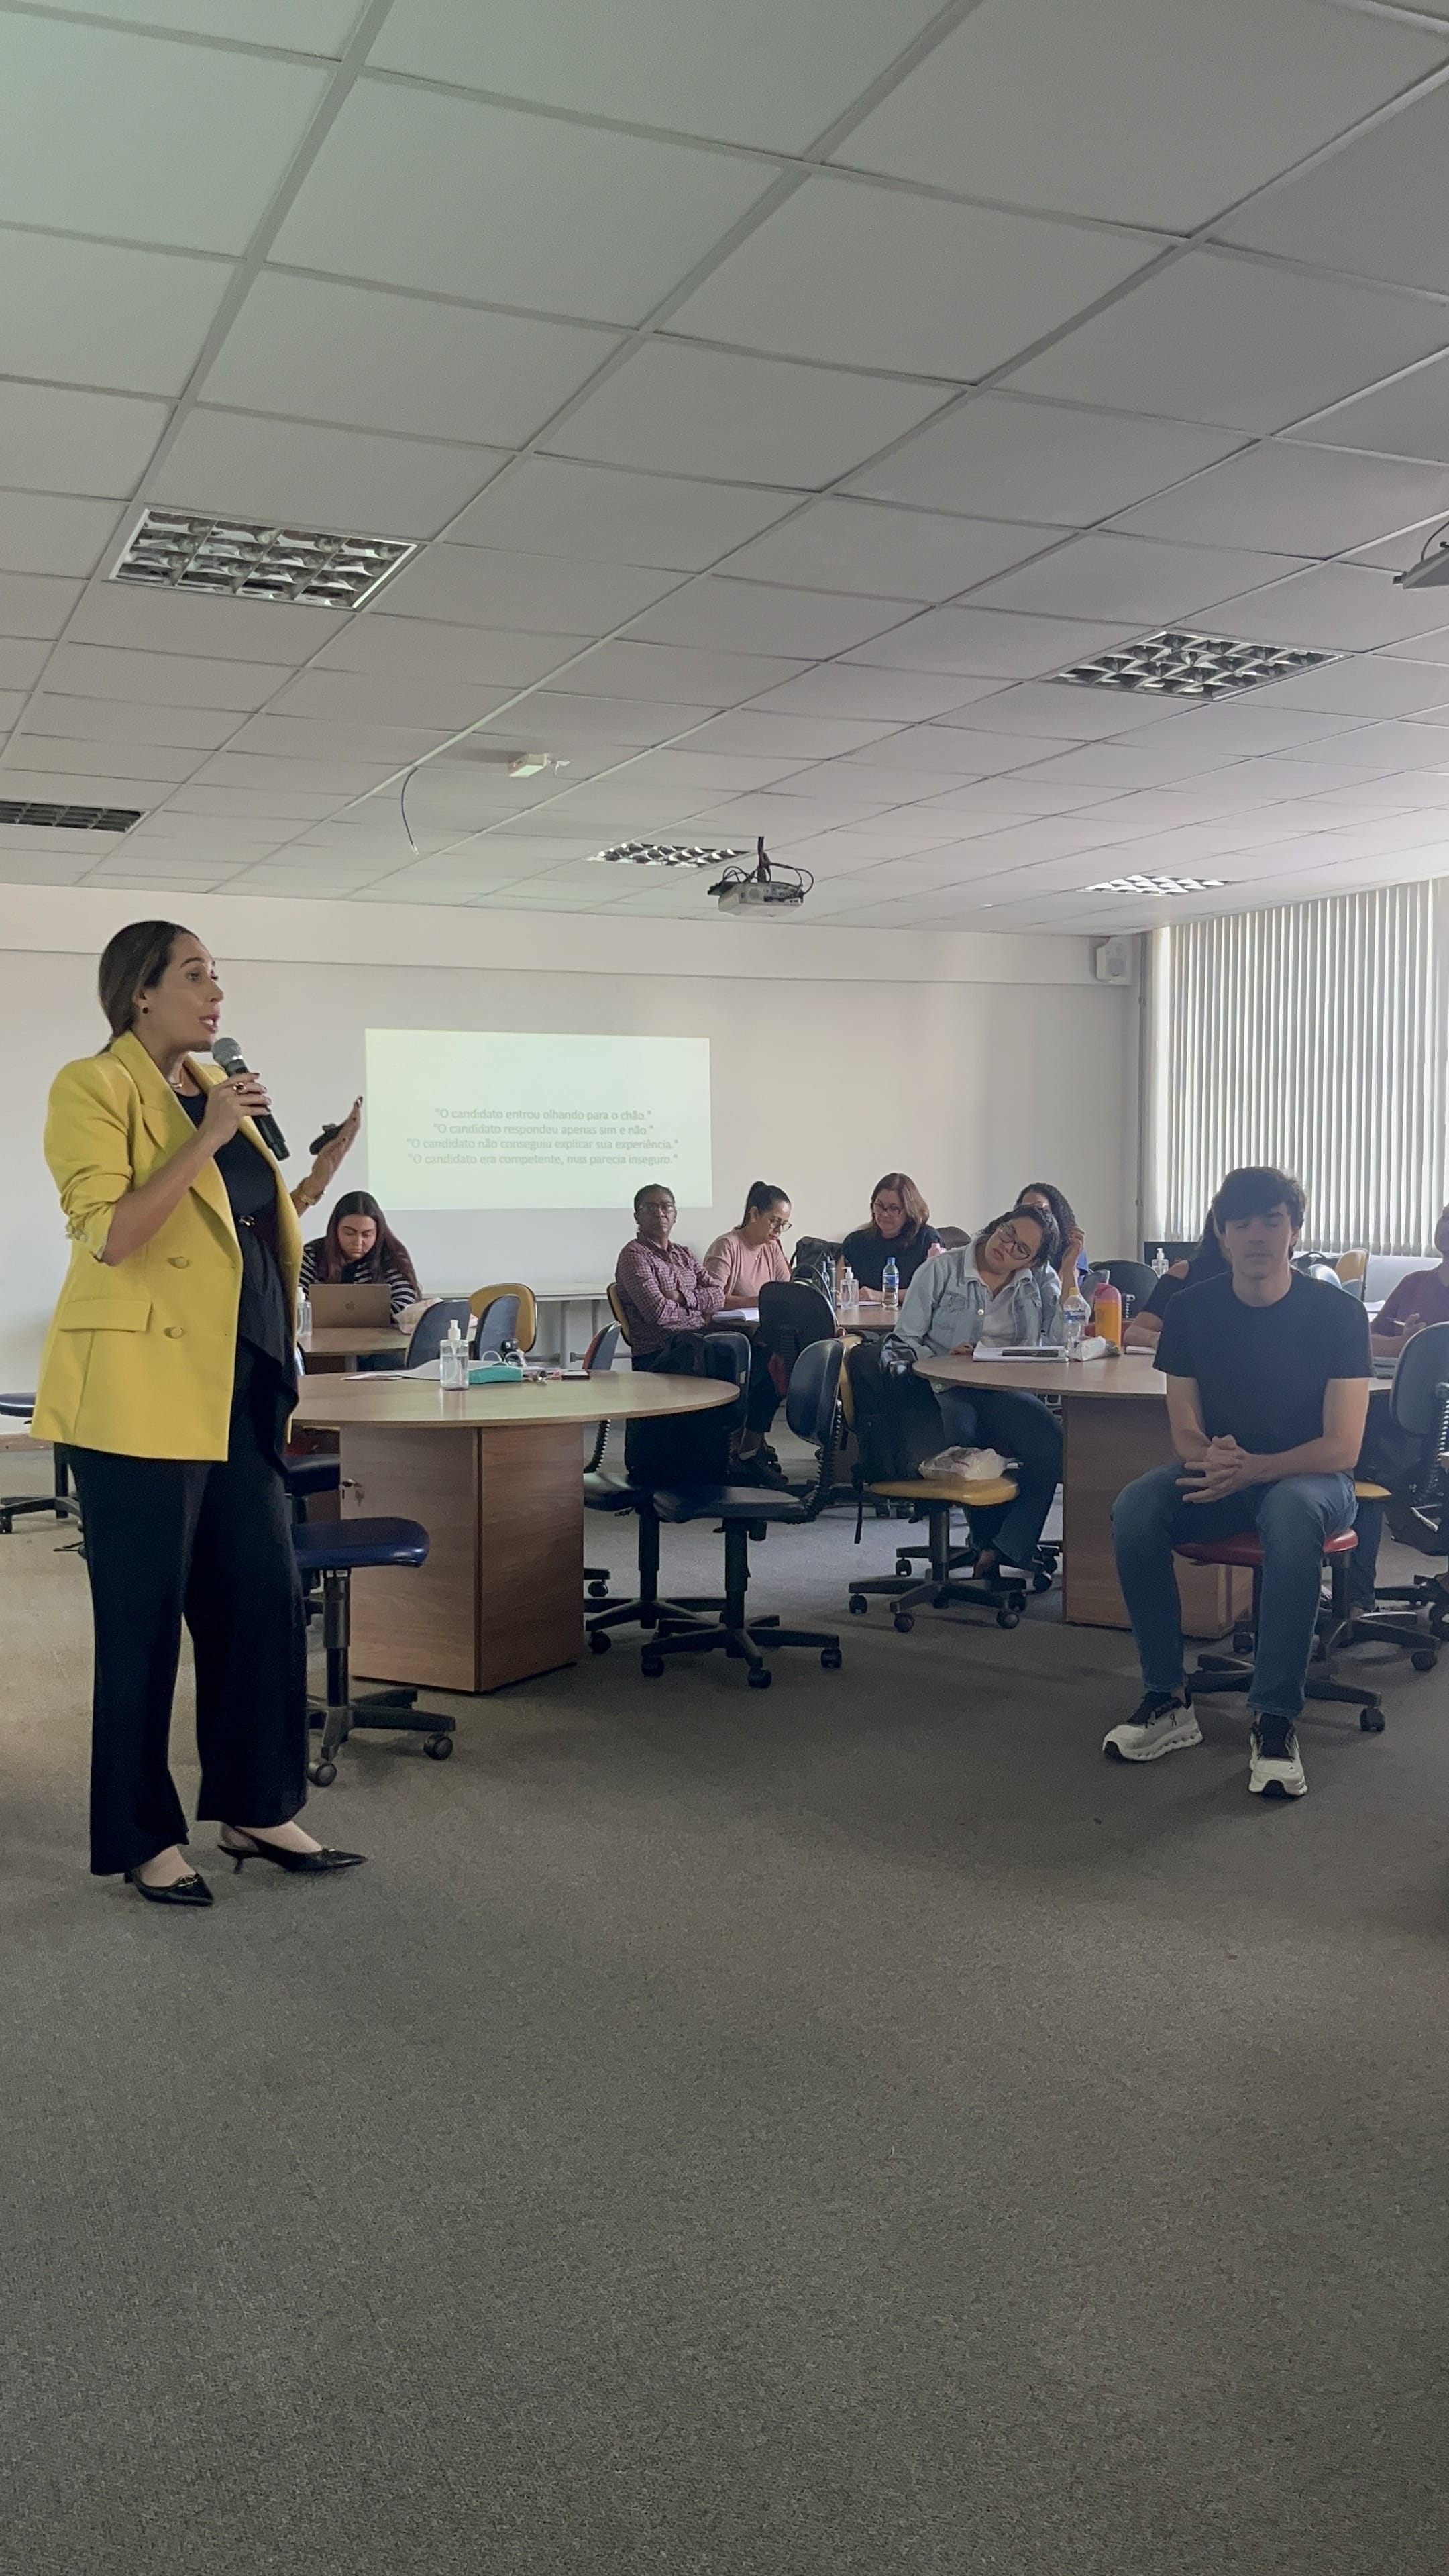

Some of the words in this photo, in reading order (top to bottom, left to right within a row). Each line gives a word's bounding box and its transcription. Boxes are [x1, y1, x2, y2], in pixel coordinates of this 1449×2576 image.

[451, 1108, 503, 1120] candidato
[506, 1110, 540, 1120] entrou
[543, 1109, 584, 1120] olhando
[586, 1112, 608, 1122] para
[611, 1112, 618, 1120] o
[449, 1124, 501, 1134] candidato
[504, 1124, 558, 1136] respondeu
[561, 1126, 596, 1136] apenas
[599, 1125, 616, 1134] sim
[619, 1126, 626, 1134] e
[423, 1138, 475, 1149] candidato
[478, 1138, 498, 1149] não
[500, 1138, 552, 1150] conseguiu
[555, 1139, 594, 1150] explicar
[595, 1140, 613, 1149] sua
[424, 1153, 477, 1165] candidato
[480, 1155, 496, 1164] era
[499, 1154, 564, 1166] competente,
[566, 1155, 587, 1165] mas
[590, 1155, 627, 1166] parecia
